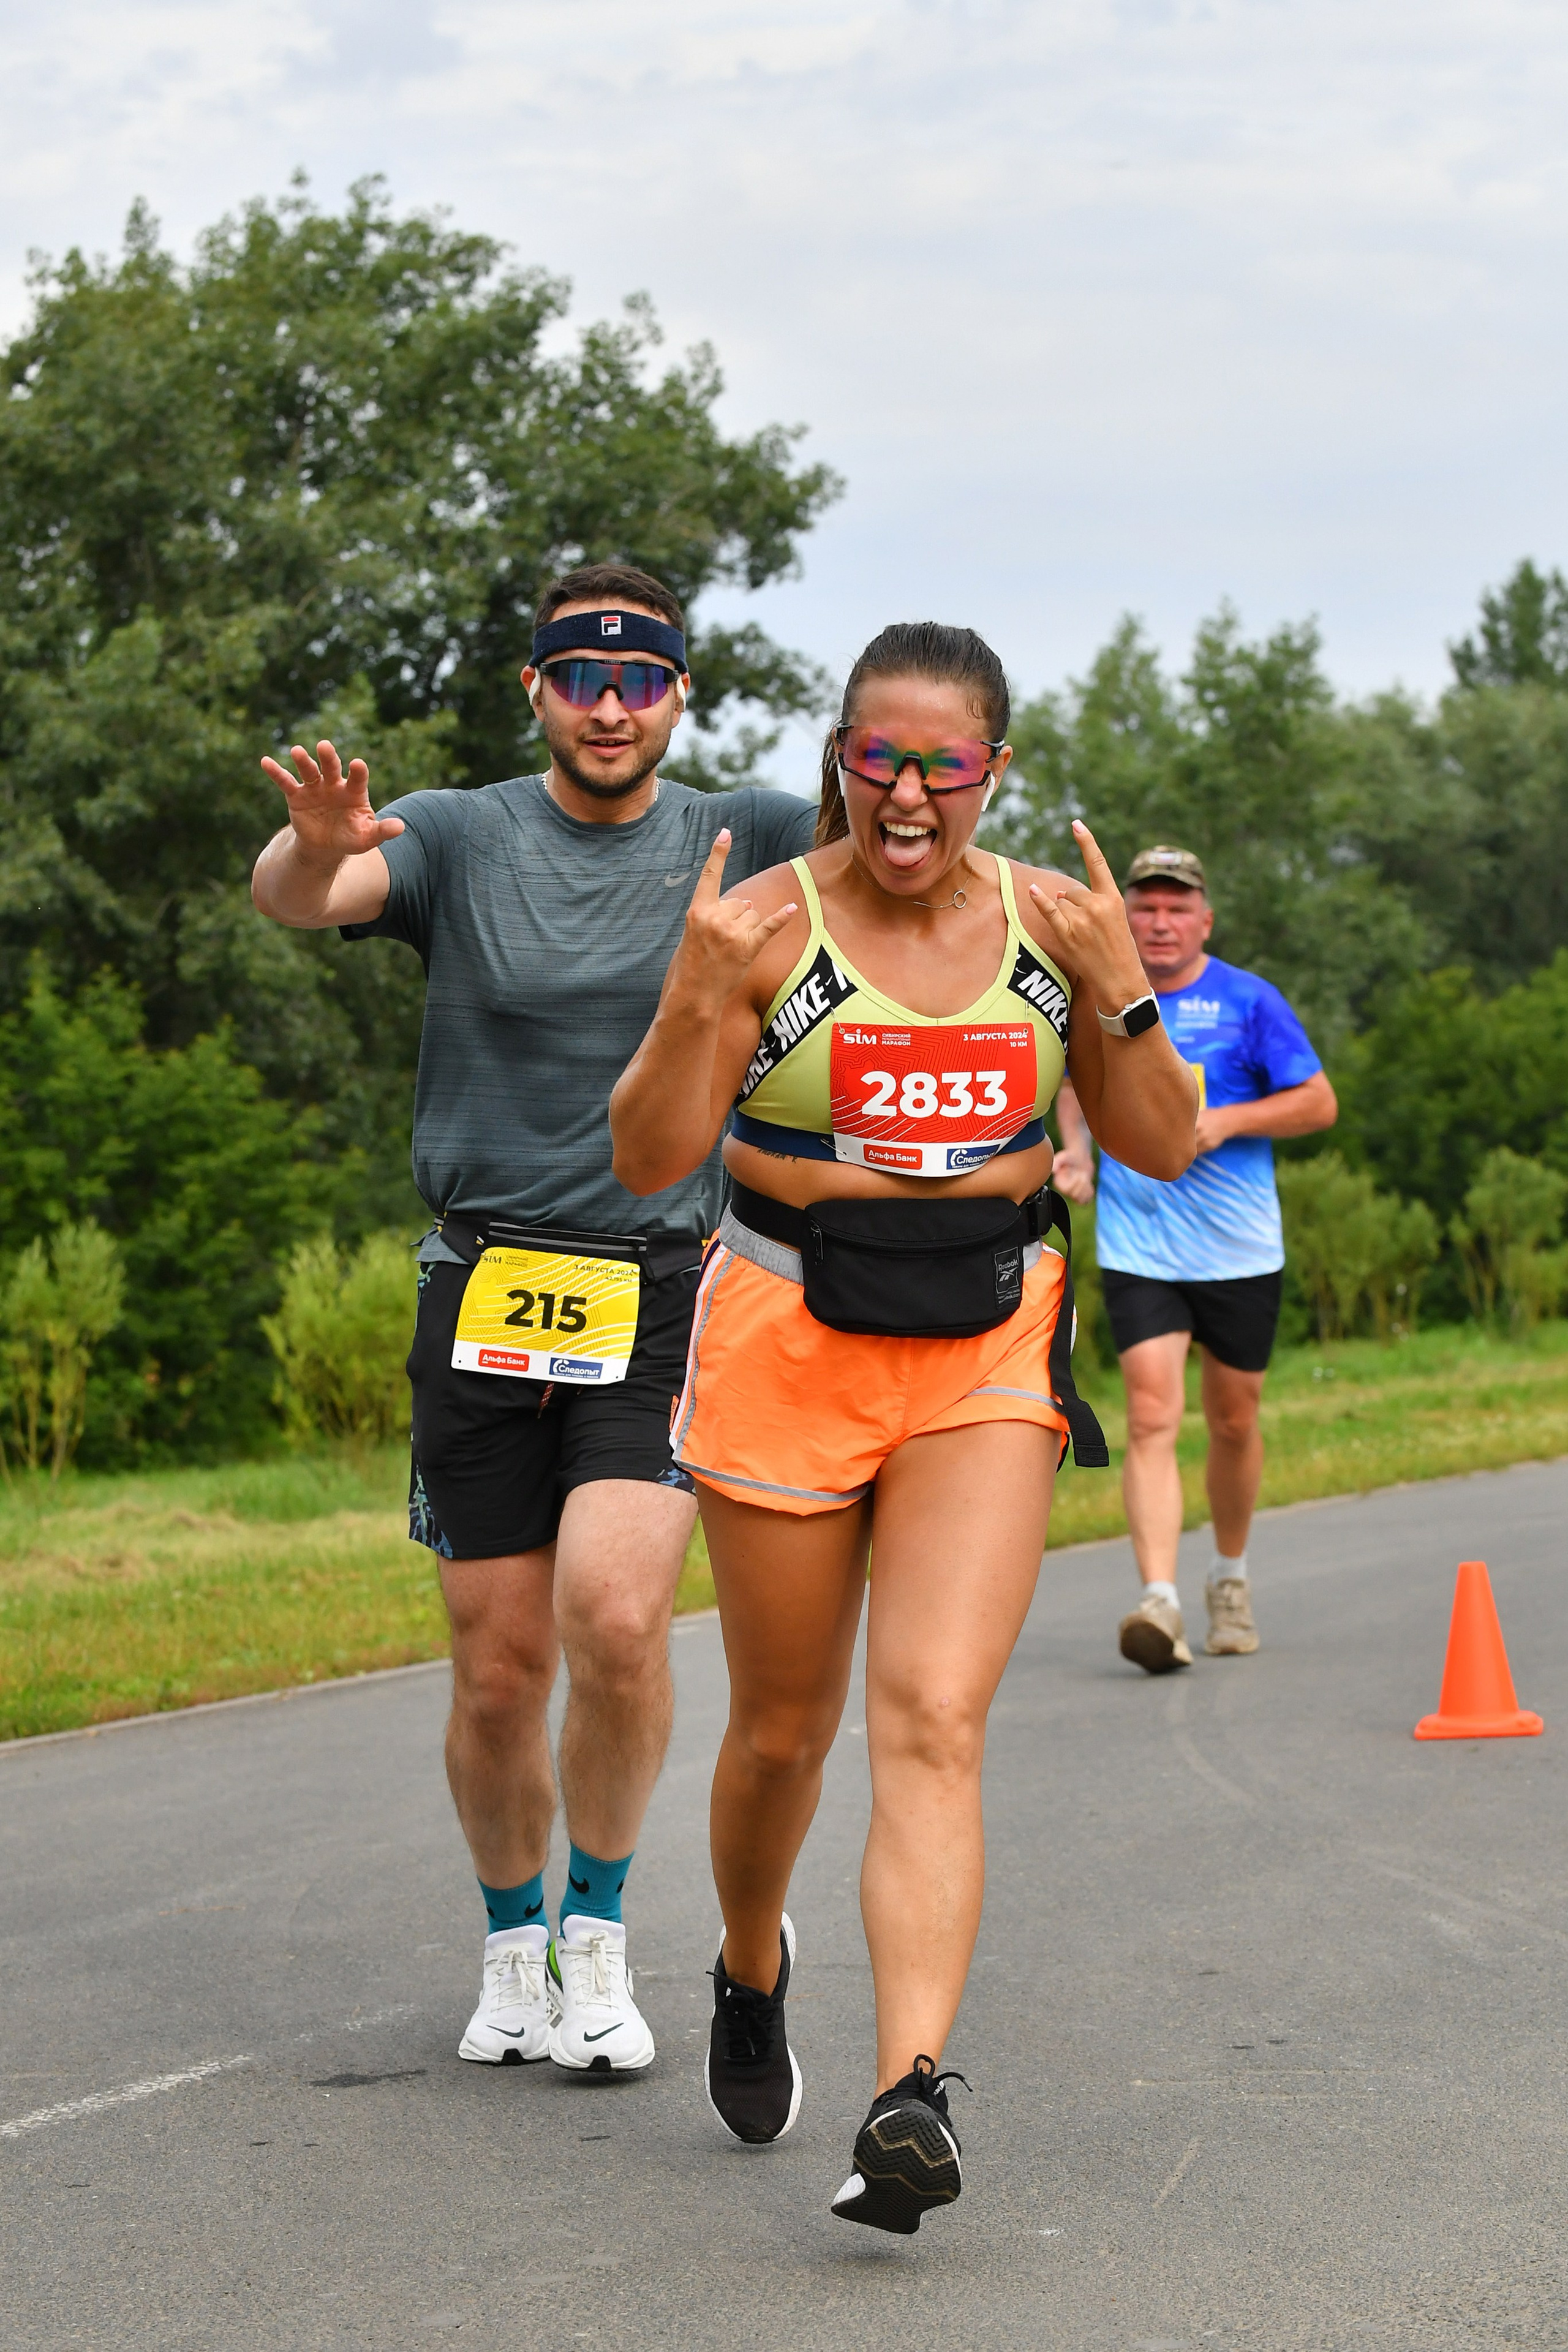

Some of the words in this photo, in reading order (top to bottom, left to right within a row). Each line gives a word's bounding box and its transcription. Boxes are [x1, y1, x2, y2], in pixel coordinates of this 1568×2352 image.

[771, 973, 831, 1052] NIKE
[1017, 970, 1068, 1033] NIKE
[860, 1070, 1008, 1118] 2833
[868, 1150, 894, 1161] Альфа
[896, 1153, 918, 1162] Банк
[504, 1289, 587, 1333] 215
[481, 1354, 506, 1364] Альфа
[507, 1357, 526, 1366] Банк
[558, 1364, 600, 1376] Следопыт
